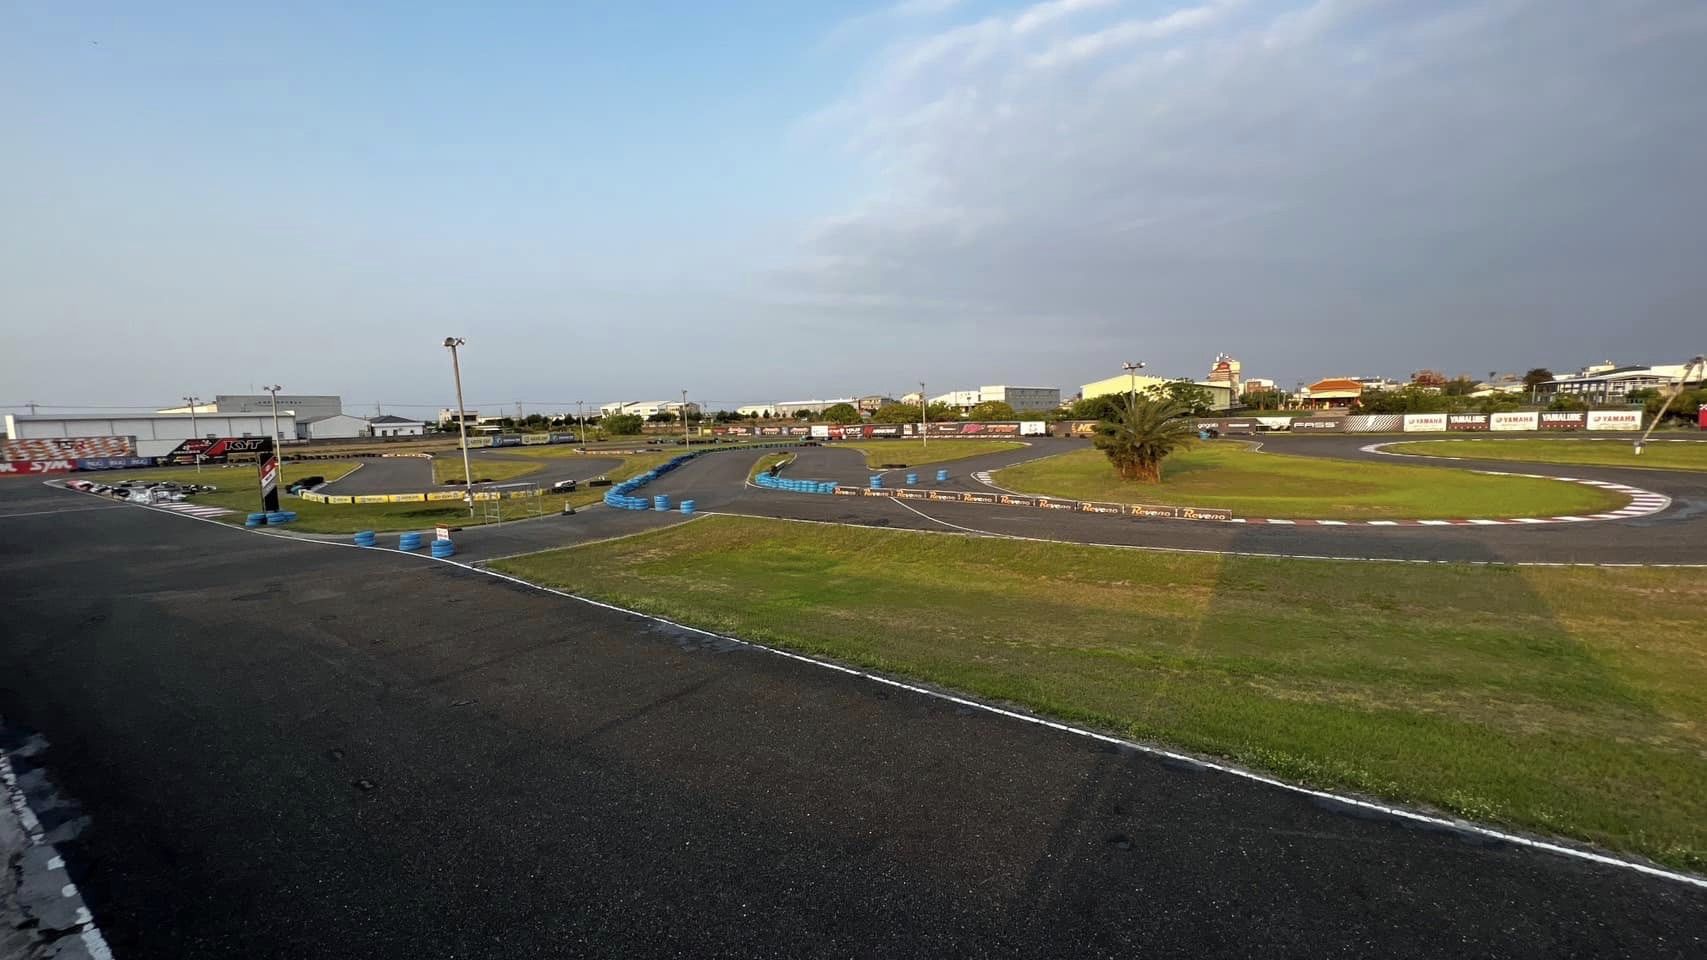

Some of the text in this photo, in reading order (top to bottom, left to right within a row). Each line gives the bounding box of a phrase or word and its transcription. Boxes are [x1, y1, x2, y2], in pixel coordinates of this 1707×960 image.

[223, 440, 263, 450] KYT
[30, 461, 72, 472] SYM
[929, 491, 955, 500] Reveno
[964, 492, 992, 502] Reveno
[1000, 495, 1030, 505] Reveno
[1040, 499, 1071, 509] Reveno
[1082, 503, 1118, 513] Reveno
[1131, 505, 1171, 517] Reveno
[1183, 508, 1226, 520] Reveno
